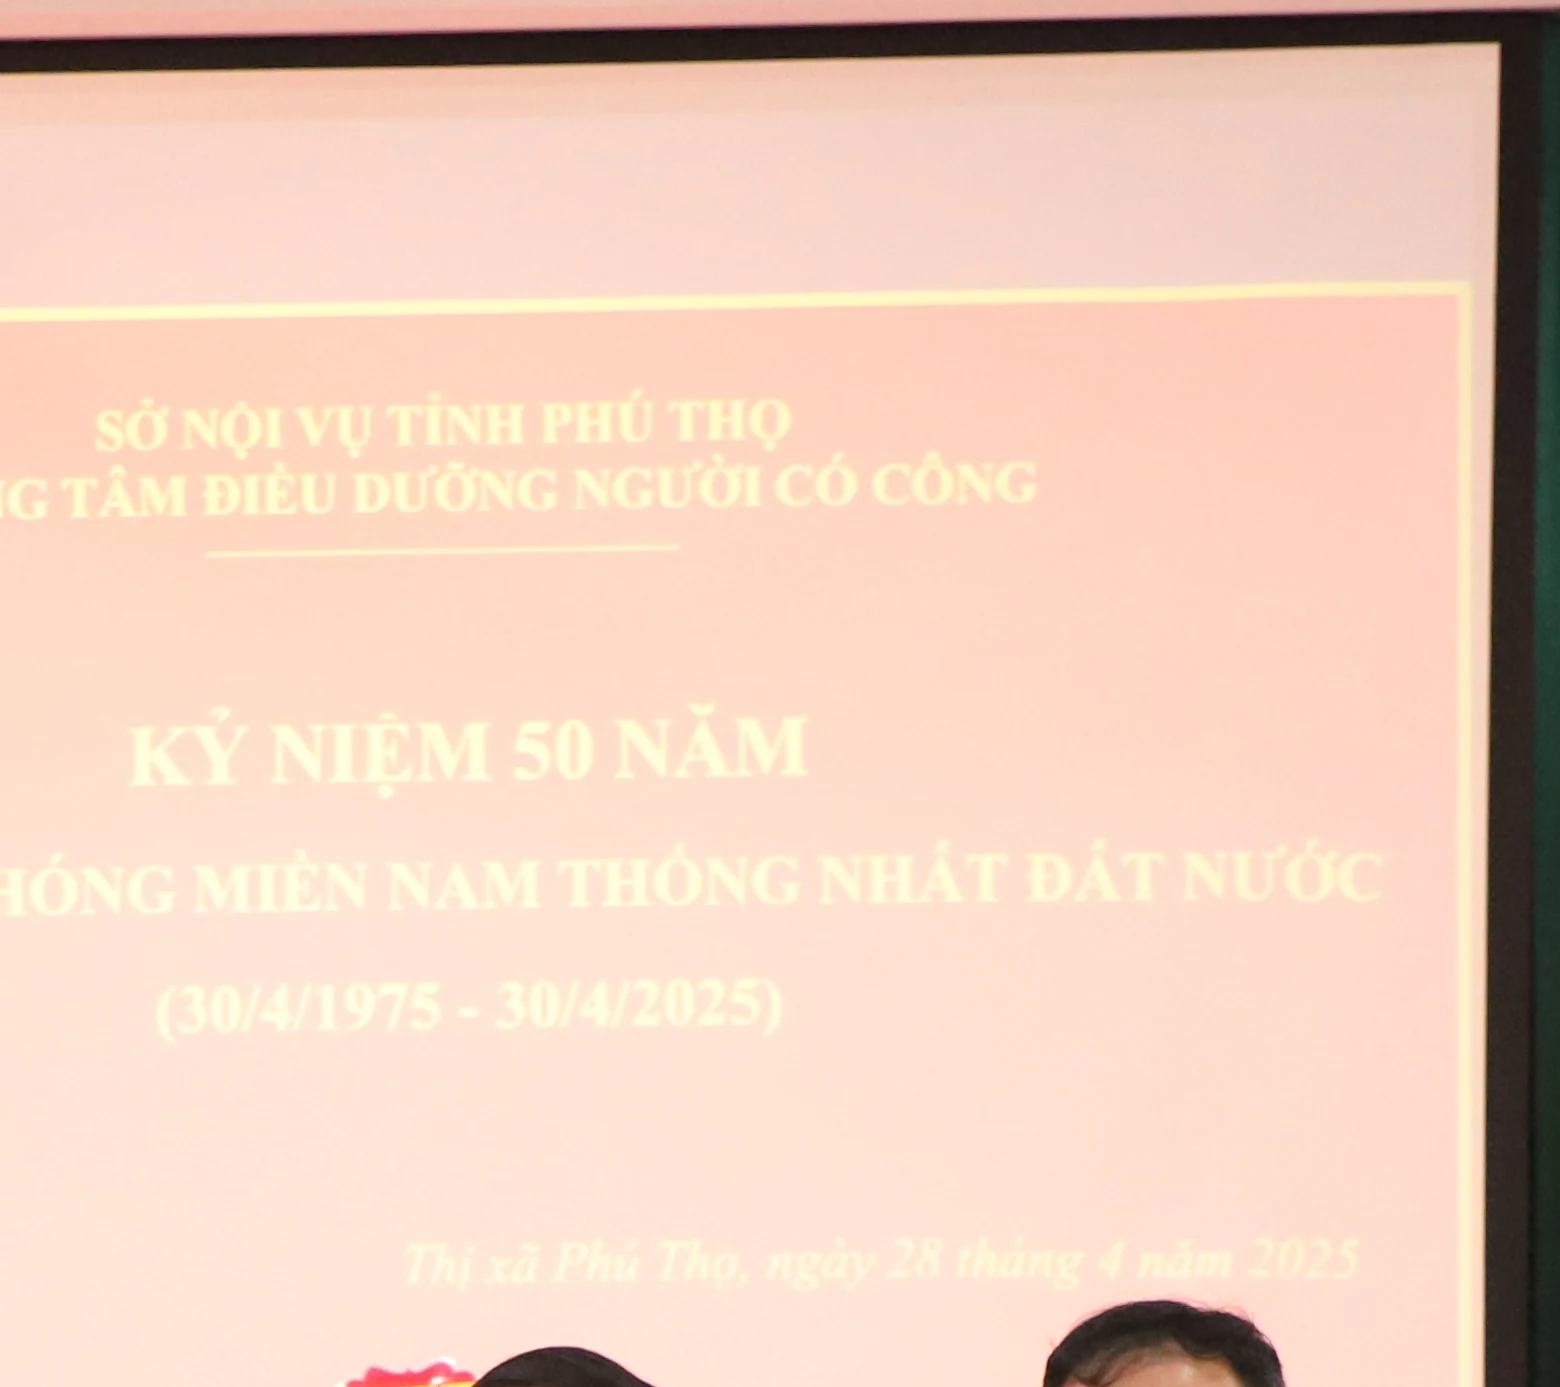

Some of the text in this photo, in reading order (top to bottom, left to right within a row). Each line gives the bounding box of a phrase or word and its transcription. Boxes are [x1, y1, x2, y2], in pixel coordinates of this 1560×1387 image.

[95, 389, 793, 459] SỞ NỘI VỤ TỈNH PHÚ THỌ
[60, 464, 188, 519] TÂM
[352, 461, 558, 513] DƯỠNG
[572, 454, 761, 510] NGƯỜI
[774, 451, 858, 506] CÓ
[871, 450, 1038, 505] CÔNG
[127, 701, 810, 799] KỶ NIỆM 50 NĂM
[387, 860, 541, 911] NAM
[557, 842, 802, 908] THỐNG
[819, 838, 1009, 904] NHẤT
[1025, 838, 1167, 903] ĐẤT
[1181, 838, 1383, 903] NƯỚC
[155, 981, 442, 1044] (30/4/1975
[494, 976, 783, 1037] 30/4/2025)
[405, 1236, 1360, 1293] Thị xã Phú Thọ, ngày 28 tháng 4 năm 2025
